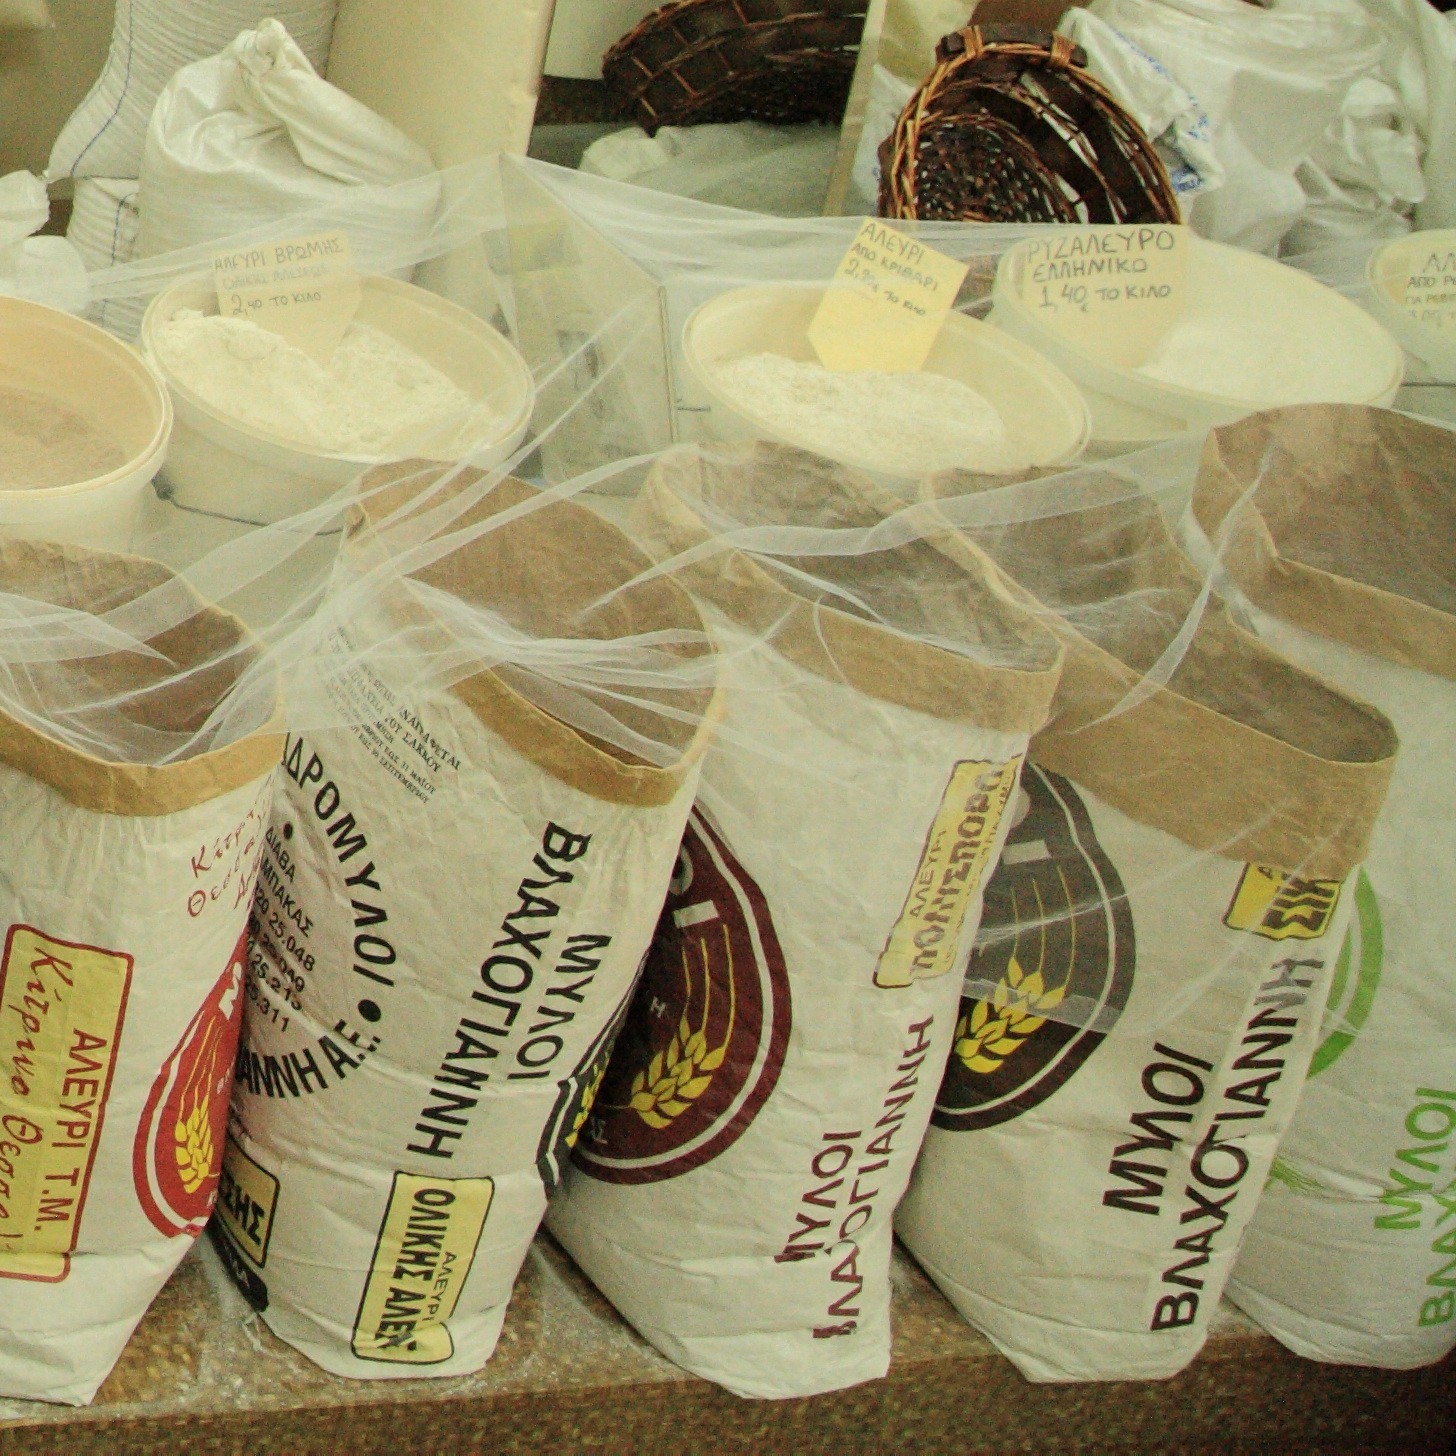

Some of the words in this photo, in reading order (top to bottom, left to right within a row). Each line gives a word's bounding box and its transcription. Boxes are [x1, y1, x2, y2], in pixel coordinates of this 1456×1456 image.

[214, 250, 266, 272] ΑΛΕΥΡΙ
[274, 237, 345, 265] ΒΡΩΜΗΣ
[851, 242, 877, 263] ΑΠΟ
[879, 255, 938, 293] ΚΡΙΘΑΡΙ
[860, 221, 925, 265] ΑΛΕΥΡΙ
[1027, 228, 1175, 264] ΡΥΖΑΛΕΥΡΟ
[1032, 258, 1148, 284] ΕΛΛΗΝΙΚΟ
[268, 296, 288, 307] ΤΟ
[292, 291, 322, 304] ΚΙΛΟ
[1096, 287, 1119, 301] ΤΟ
[1125, 284, 1172, 300] ΚΙΛΟ
[264, 823, 296, 884] ΔΙΑΒΑ
[268, 911, 315, 972] 25.048
[7, 946, 75, 1097] Κίτρινο
[405, 820, 592, 1159] ΒΛΑΧΟΓΙΑΝΝΗ
[507, 933, 612, 1081] ΜΥΛΟΙ
[51, 1028, 108, 1149] ΑΛΕΥΡΙ
[1102, 1041, 1215, 1217] ΜΥΛΟΙ
[1149, 956, 1326, 1333] ΒΛΑΧΟΓΙΑΝΝΗ
[1373, 1086, 1456, 1231] ΜΥΛΟΙ
[34, 1167, 80, 1232] Τ.Μ.
[393, 1187, 456, 1289] ΟΛΙΚΗΣ
[424, 1250, 457, 1323] ΑΛΕΥΡΙ
